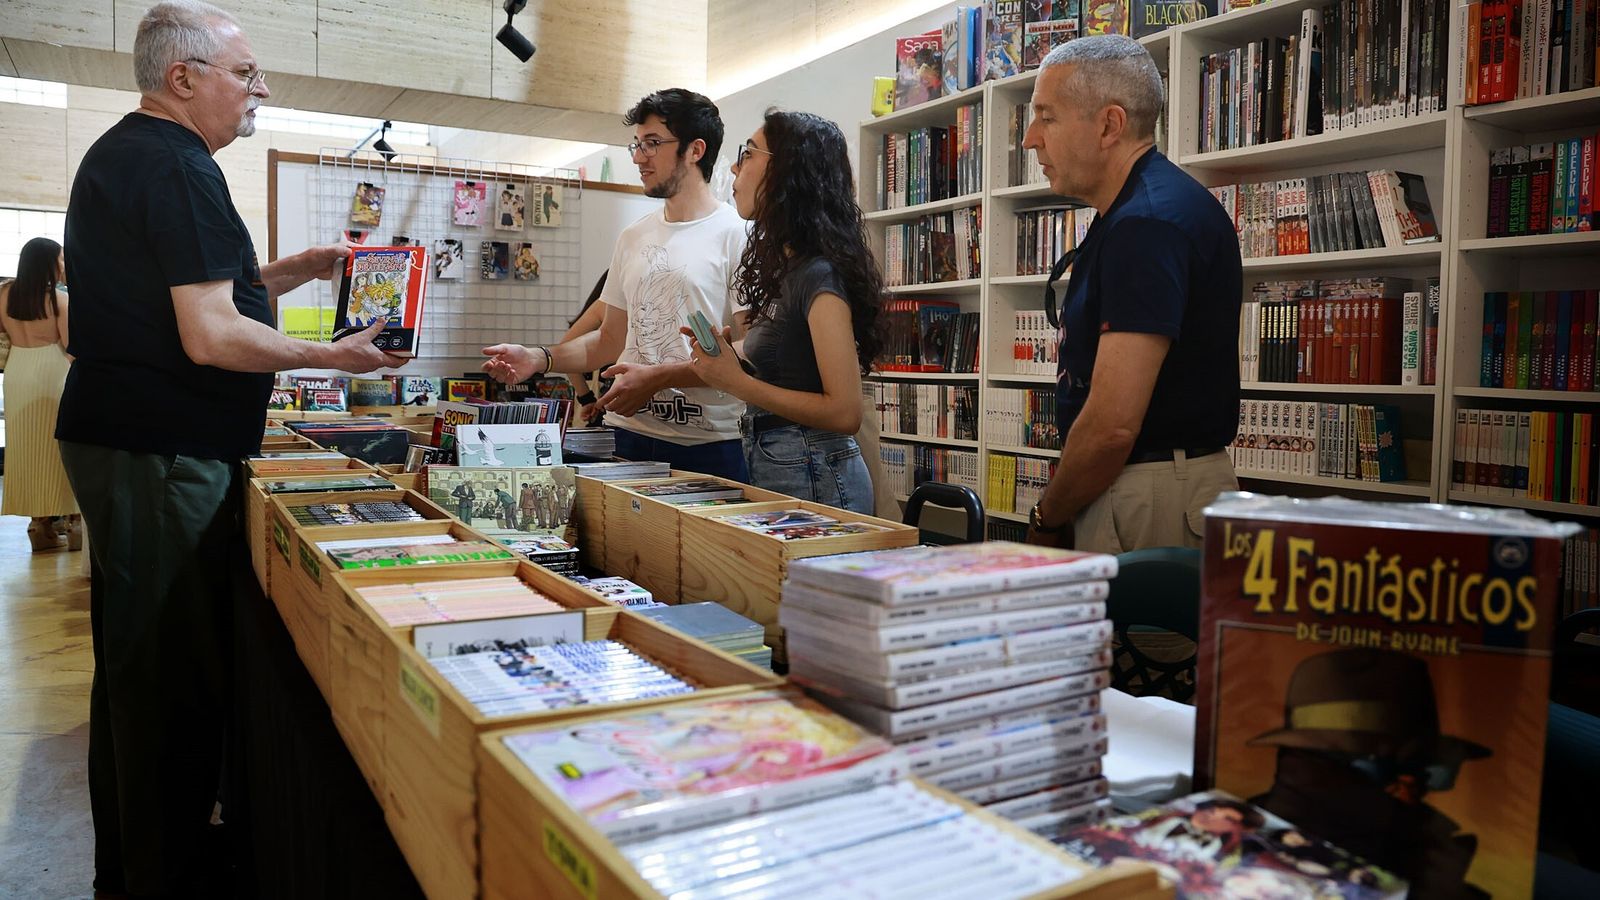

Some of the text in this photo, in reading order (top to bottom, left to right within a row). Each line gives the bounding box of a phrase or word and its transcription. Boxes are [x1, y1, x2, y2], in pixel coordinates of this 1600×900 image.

[1053, 22, 1075, 31] MAN
[1145, 4, 1208, 25] BLACKSAD
[904, 40, 939, 54] Saga
[1556, 144, 1565, 199] BECK
[1569, 142, 1577, 197] BECK
[1582, 139, 1592, 195] BECK
[1509, 178, 1521, 232] PIES DESCALZOS
[1529, 175, 1542, 230] PIES DESCALZOS
[930, 309, 949, 323] THO
[1408, 330, 1418, 369] URASAWA
[505, 384, 529, 392] BATMAN
[444, 409, 474, 426] SONIC
[1223, 521, 1253, 559] Los
[1243, 529, 1277, 612] 4
[1283, 536, 1538, 630] Fantásticos
[627, 597, 648, 606] TOKYO
[1295, 622, 1320, 641] DE
[1330, 625, 1382, 649] JOHN
